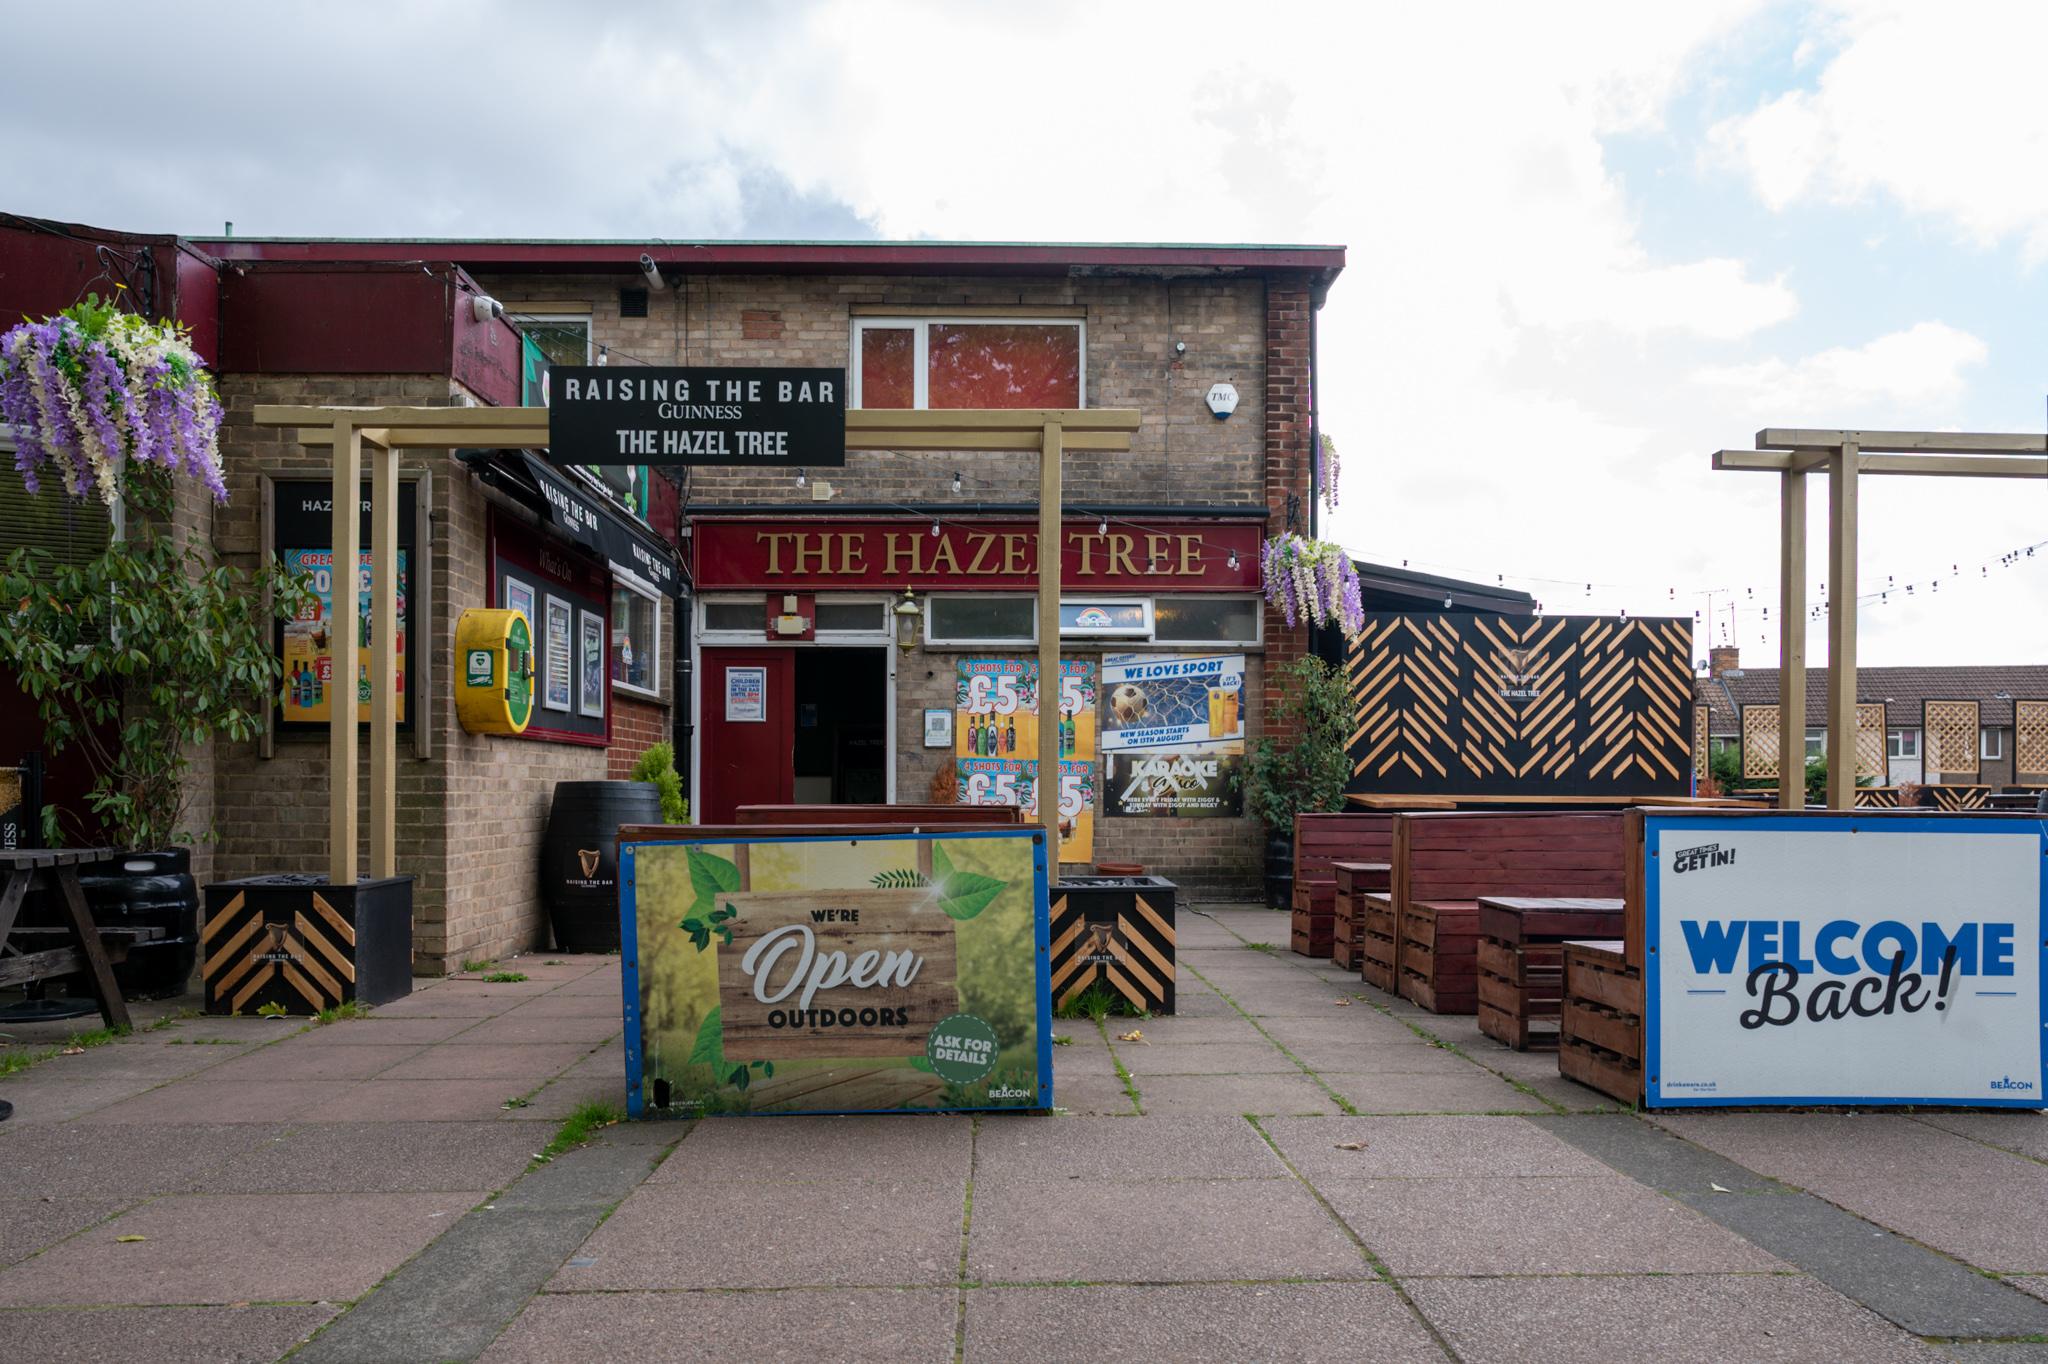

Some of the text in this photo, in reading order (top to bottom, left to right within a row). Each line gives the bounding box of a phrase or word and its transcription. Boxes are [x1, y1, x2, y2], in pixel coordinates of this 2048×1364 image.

[566, 379, 833, 402] RAISING THE BAR
[1212, 392, 1233, 401] TMC
[658, 402, 742, 420] GUINNESS
[616, 430, 788, 456] THE HAZEL TREE
[302, 500, 332, 512] HAZ
[540, 480, 569, 513] RAISING
[570, 500, 583, 522] THE
[585, 509, 598, 531] BAR
[756, 531, 868, 574] THE
[1069, 532, 1207, 576] TREE
[652, 557, 661, 575] THE
[966, 663, 1022, 673] 3 SHOTS FOR
[1069, 665, 1087, 674] FOR
[1125, 660, 1223, 679] WE LOVE SPORT
[967, 674, 1018, 716] £5
[1137, 729, 1164, 737] SEASON
[1166, 726, 1189, 735] STARTS
[1156, 735, 1183, 743] AUGUST
[974, 762, 1000, 771] SHOTS
[1004, 763, 1021, 772] FOR
[1071, 765, 1088, 774] FOR
[1130, 760, 1217, 778] KARAOKE
[1673, 848, 1736, 874] GET IN!
[1677, 848, 1698, 857] GREAT
[810, 909, 859, 923] WE'RE
[1680, 920, 2014, 976] WELCOME
[742, 924, 924, 1010] Open
[1740, 945, 1956, 1030] Back!
[768, 1007, 908, 1029] OUTDOORS
[934, 1035, 992, 1053] ASK FOR
[935, 1047, 988, 1065] DETAILS
[989, 1086, 1031, 1098] BEACON
[1991, 1078, 2032, 1089] BEACON
